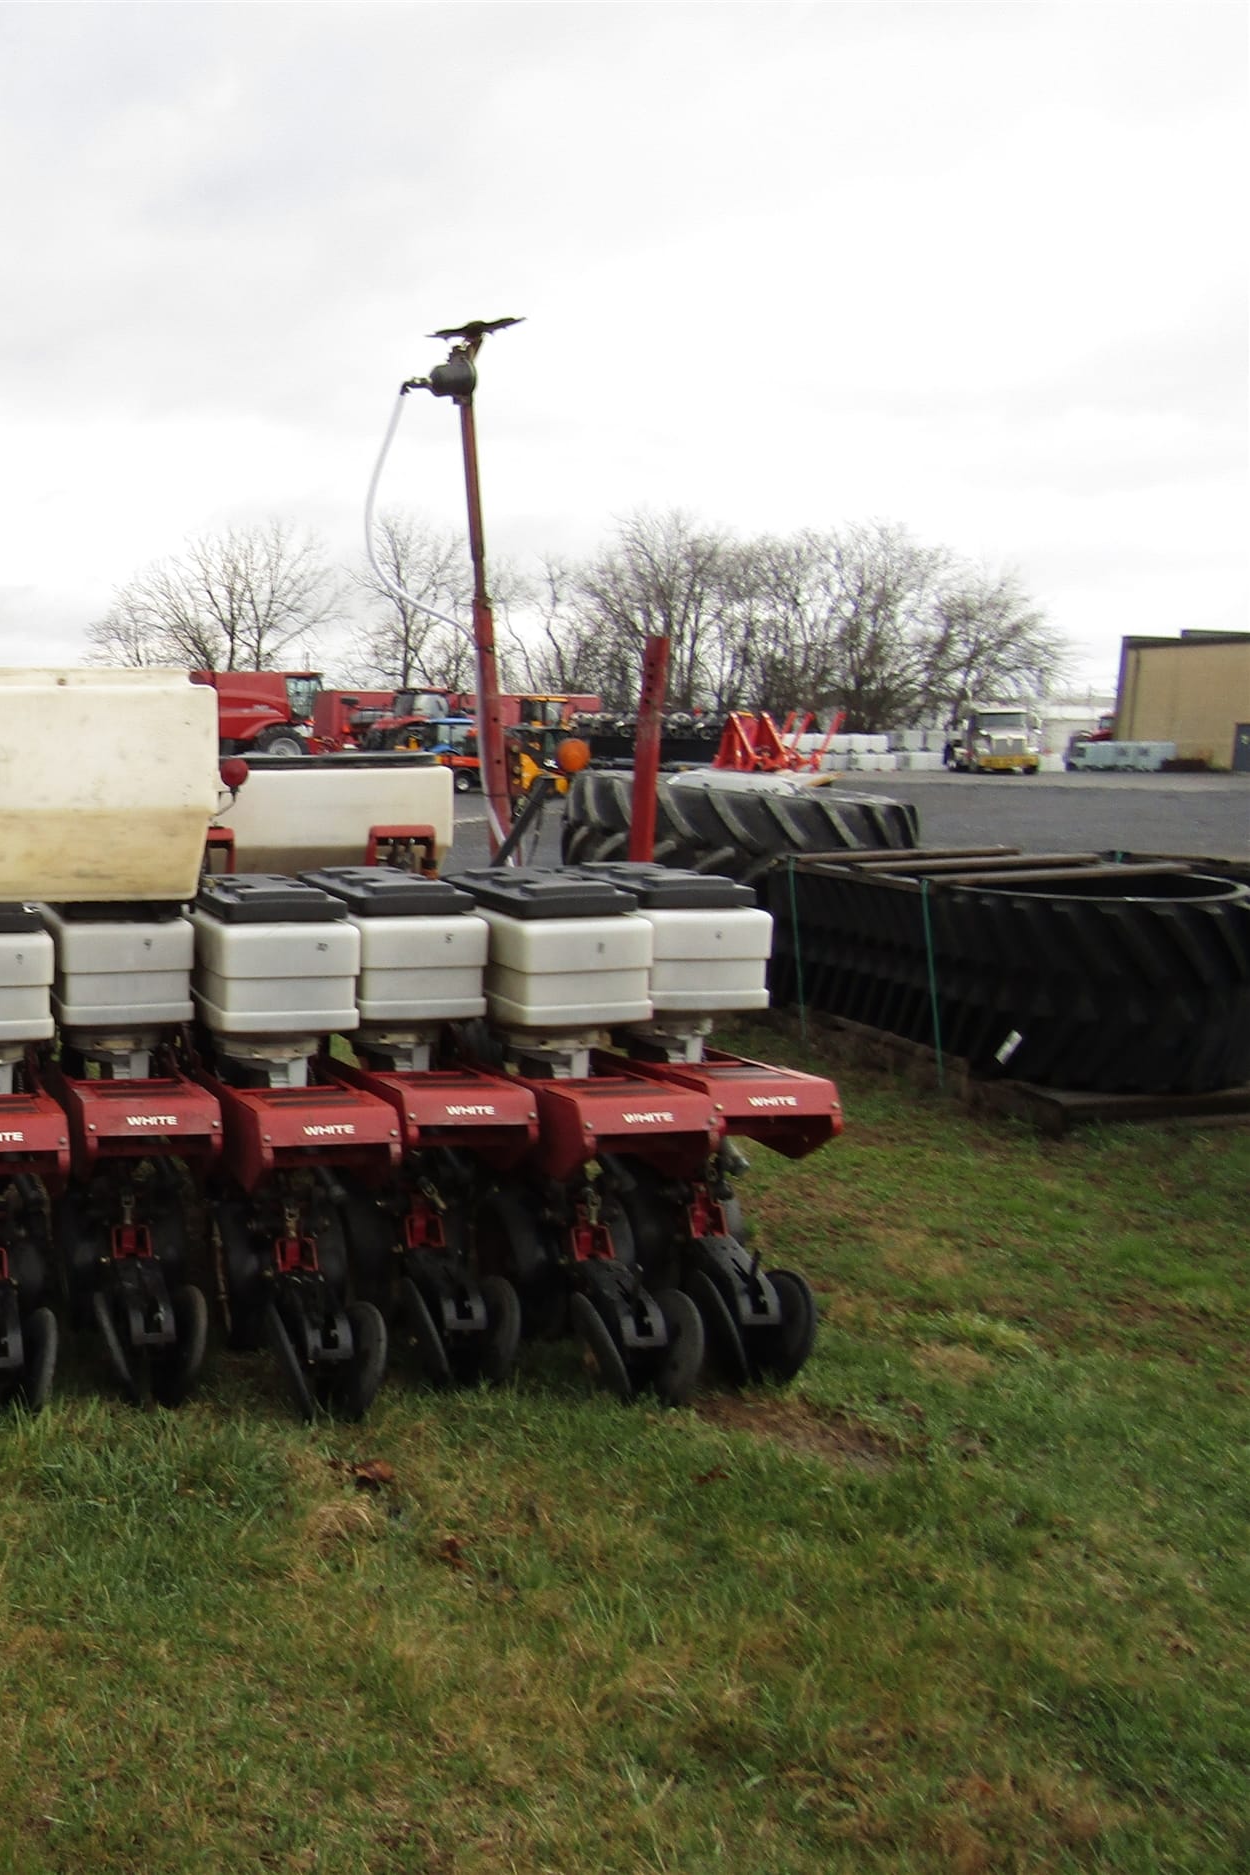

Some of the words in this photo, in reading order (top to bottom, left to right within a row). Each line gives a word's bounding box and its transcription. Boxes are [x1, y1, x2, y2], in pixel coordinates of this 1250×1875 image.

[747, 1095, 799, 1107] WHITE
[444, 1104, 497, 1116] WHITE
[125, 1115, 179, 1127] WHITE
[621, 1111, 675, 1124] WHITE
[302, 1124, 356, 1136] WHITE
